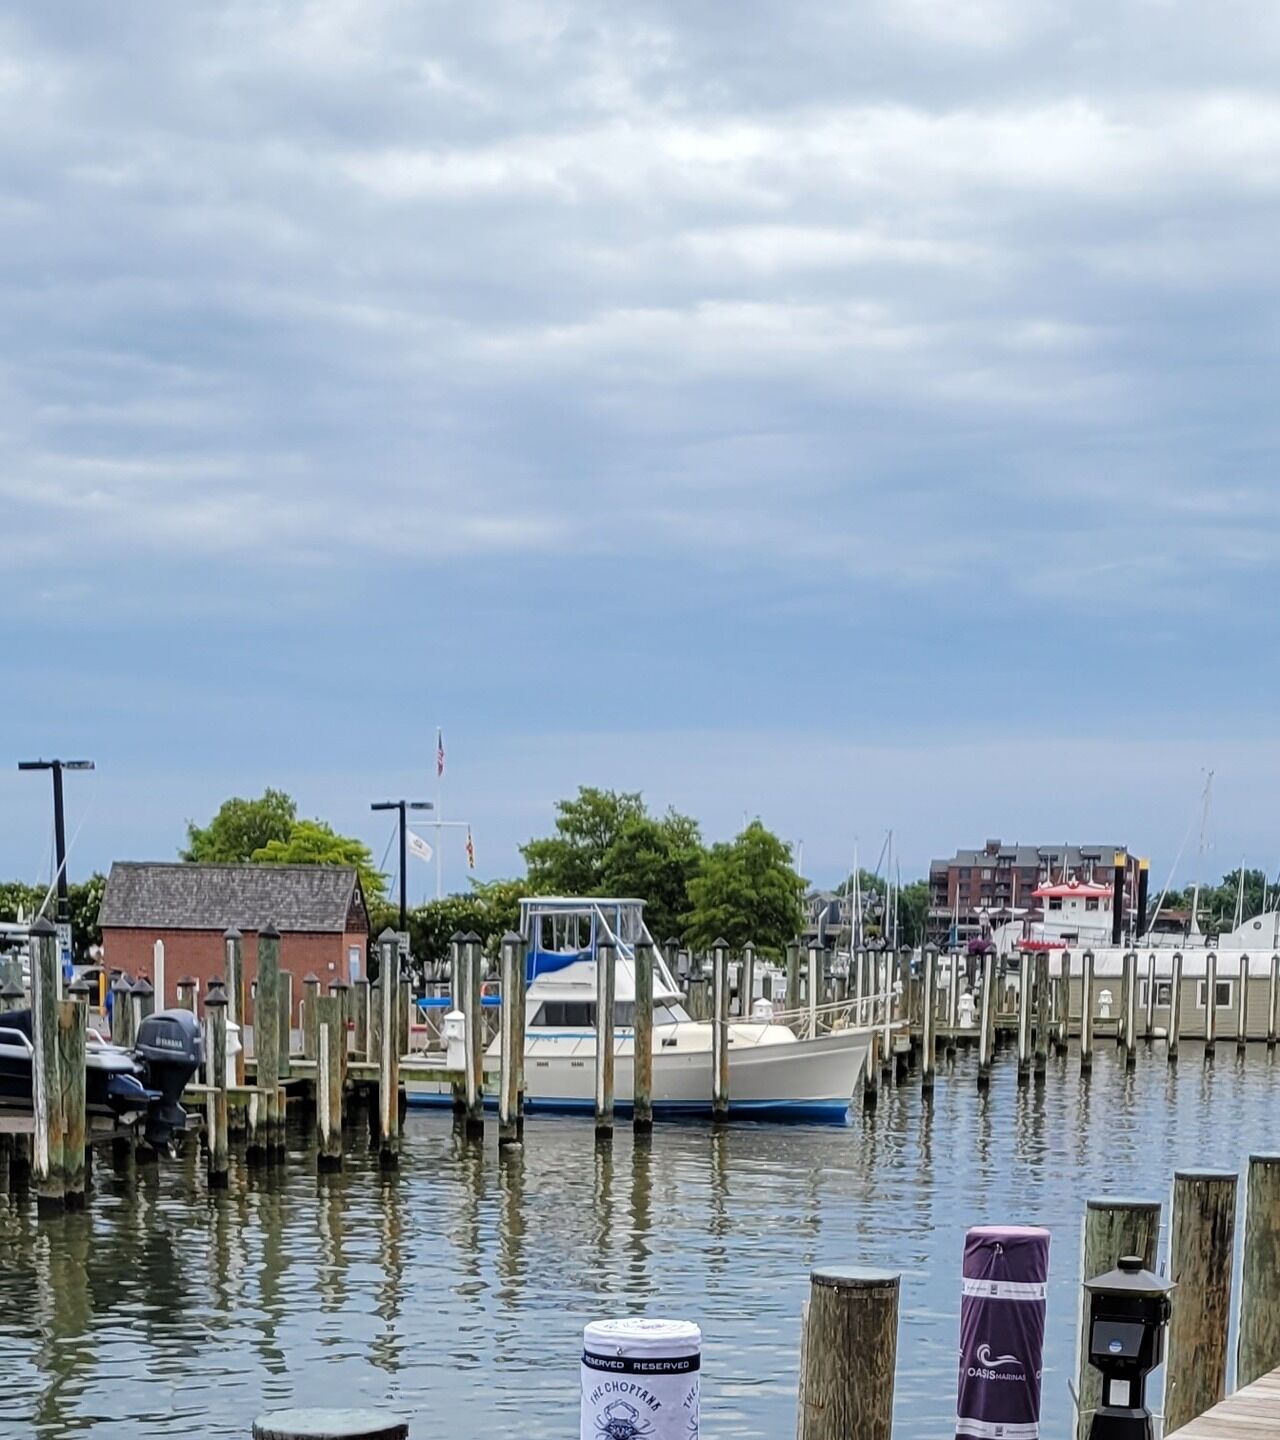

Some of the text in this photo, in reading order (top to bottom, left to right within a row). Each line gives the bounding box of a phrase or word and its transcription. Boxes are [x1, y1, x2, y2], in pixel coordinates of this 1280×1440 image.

[633, 1361, 690, 1371] RESERVED
[967, 1367, 996, 1380] OASIS
[604, 1381, 662, 1412] CHOPTANK
